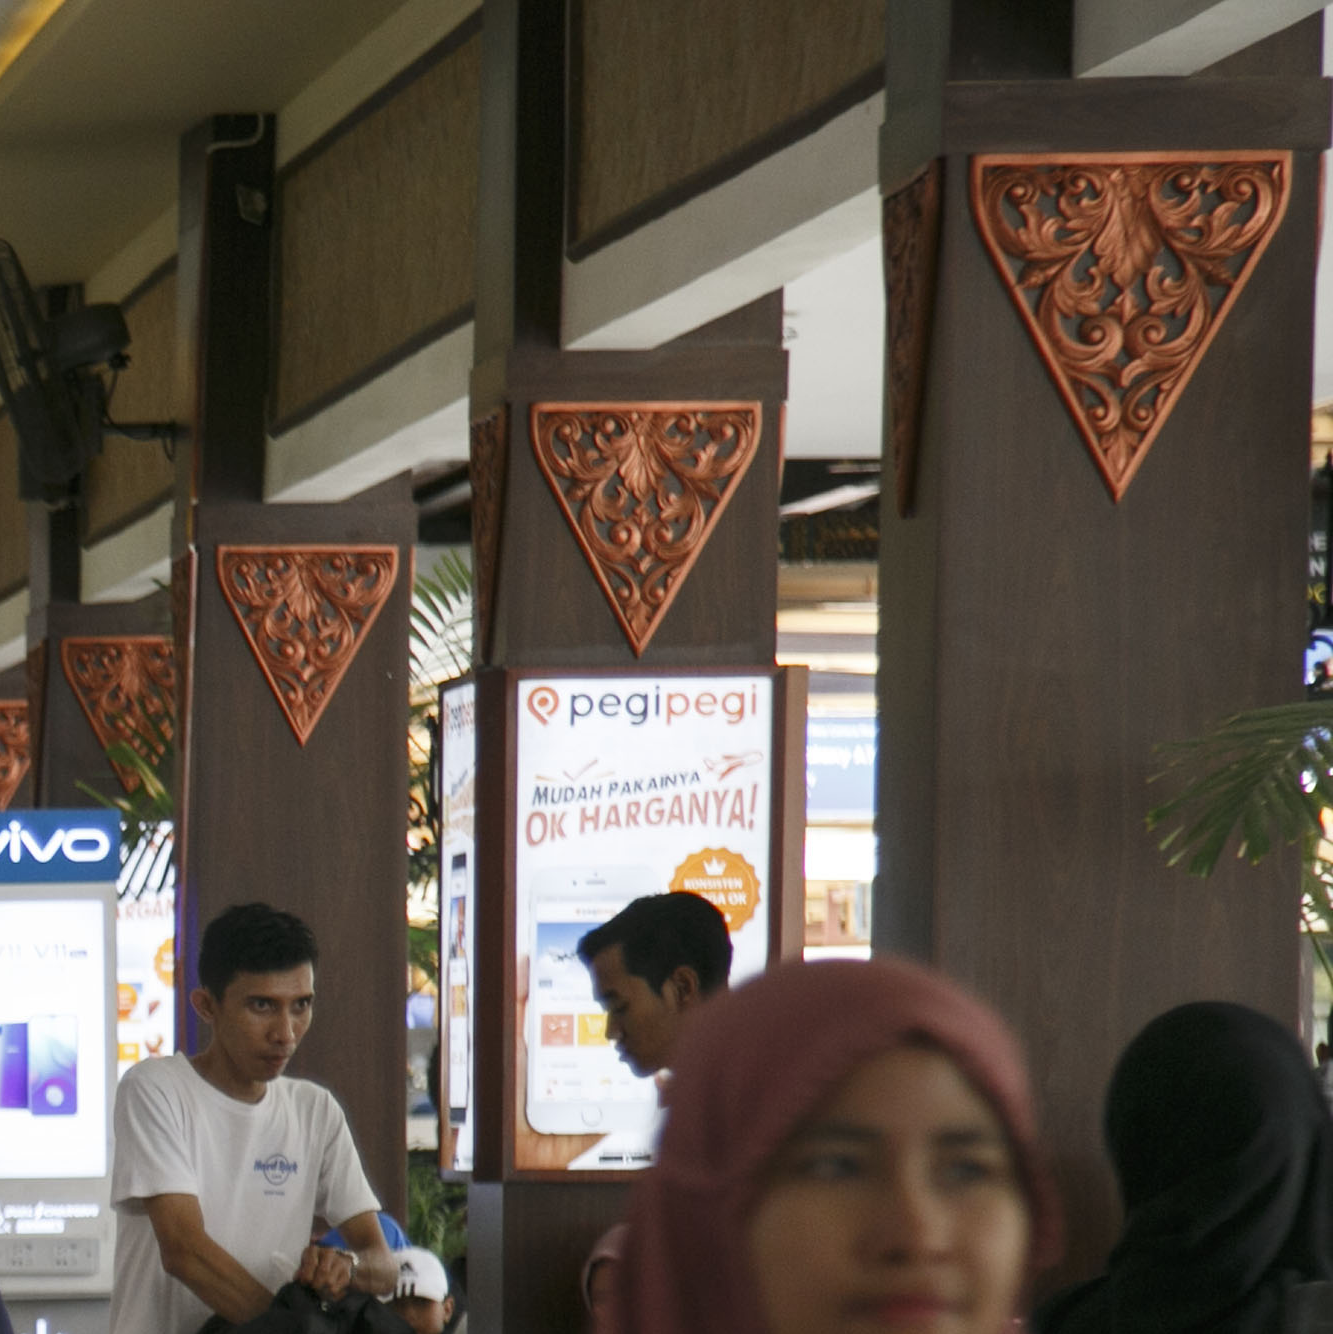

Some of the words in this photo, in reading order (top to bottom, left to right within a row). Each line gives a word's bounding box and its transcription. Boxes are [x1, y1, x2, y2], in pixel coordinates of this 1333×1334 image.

[569, 683, 757, 727] pegipegi
[531, 784, 603, 807] MUDAH
[607, 771, 701, 796] PAKAINYA
[525, 810, 568, 847] OK
[578, 783, 759, 836] HARGANYA!
